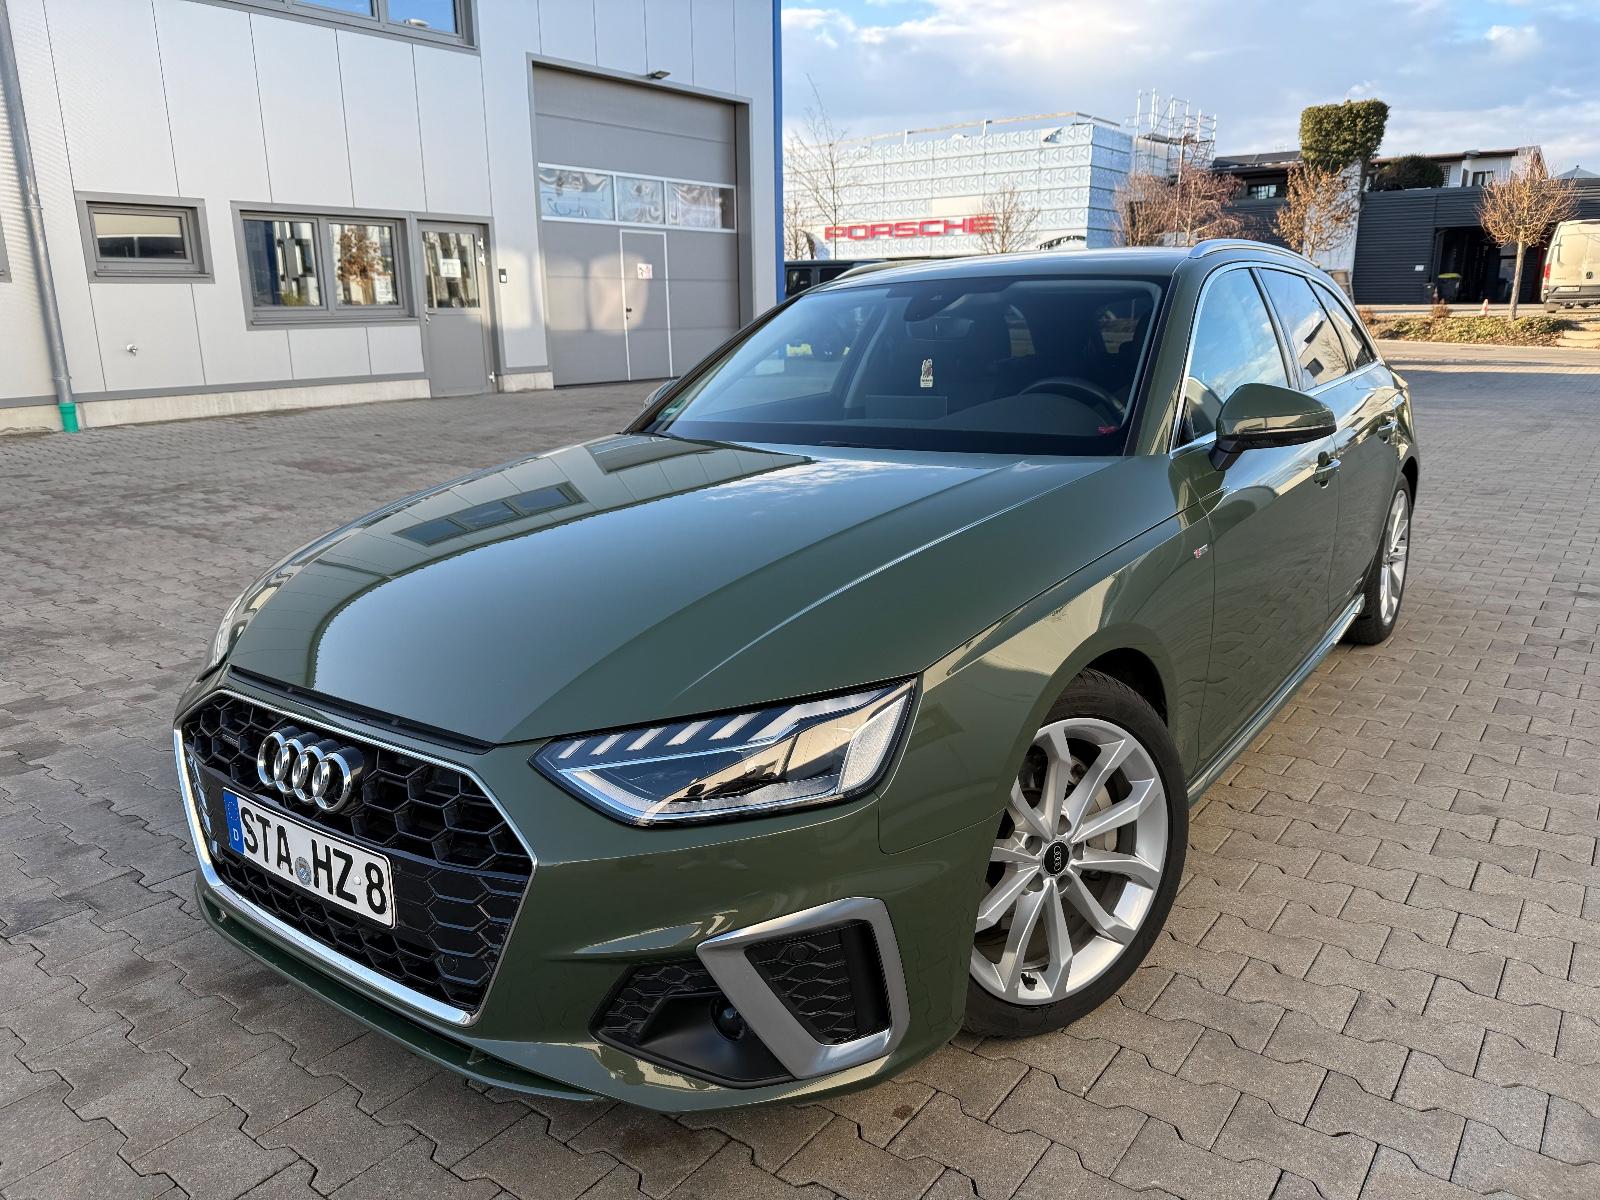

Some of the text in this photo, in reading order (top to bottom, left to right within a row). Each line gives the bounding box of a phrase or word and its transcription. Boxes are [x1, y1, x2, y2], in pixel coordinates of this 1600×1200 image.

[825, 216, 996, 241] PORSCHE
[232, 827, 239, 842] D
[240, 806, 387, 914] STA HZ 8
